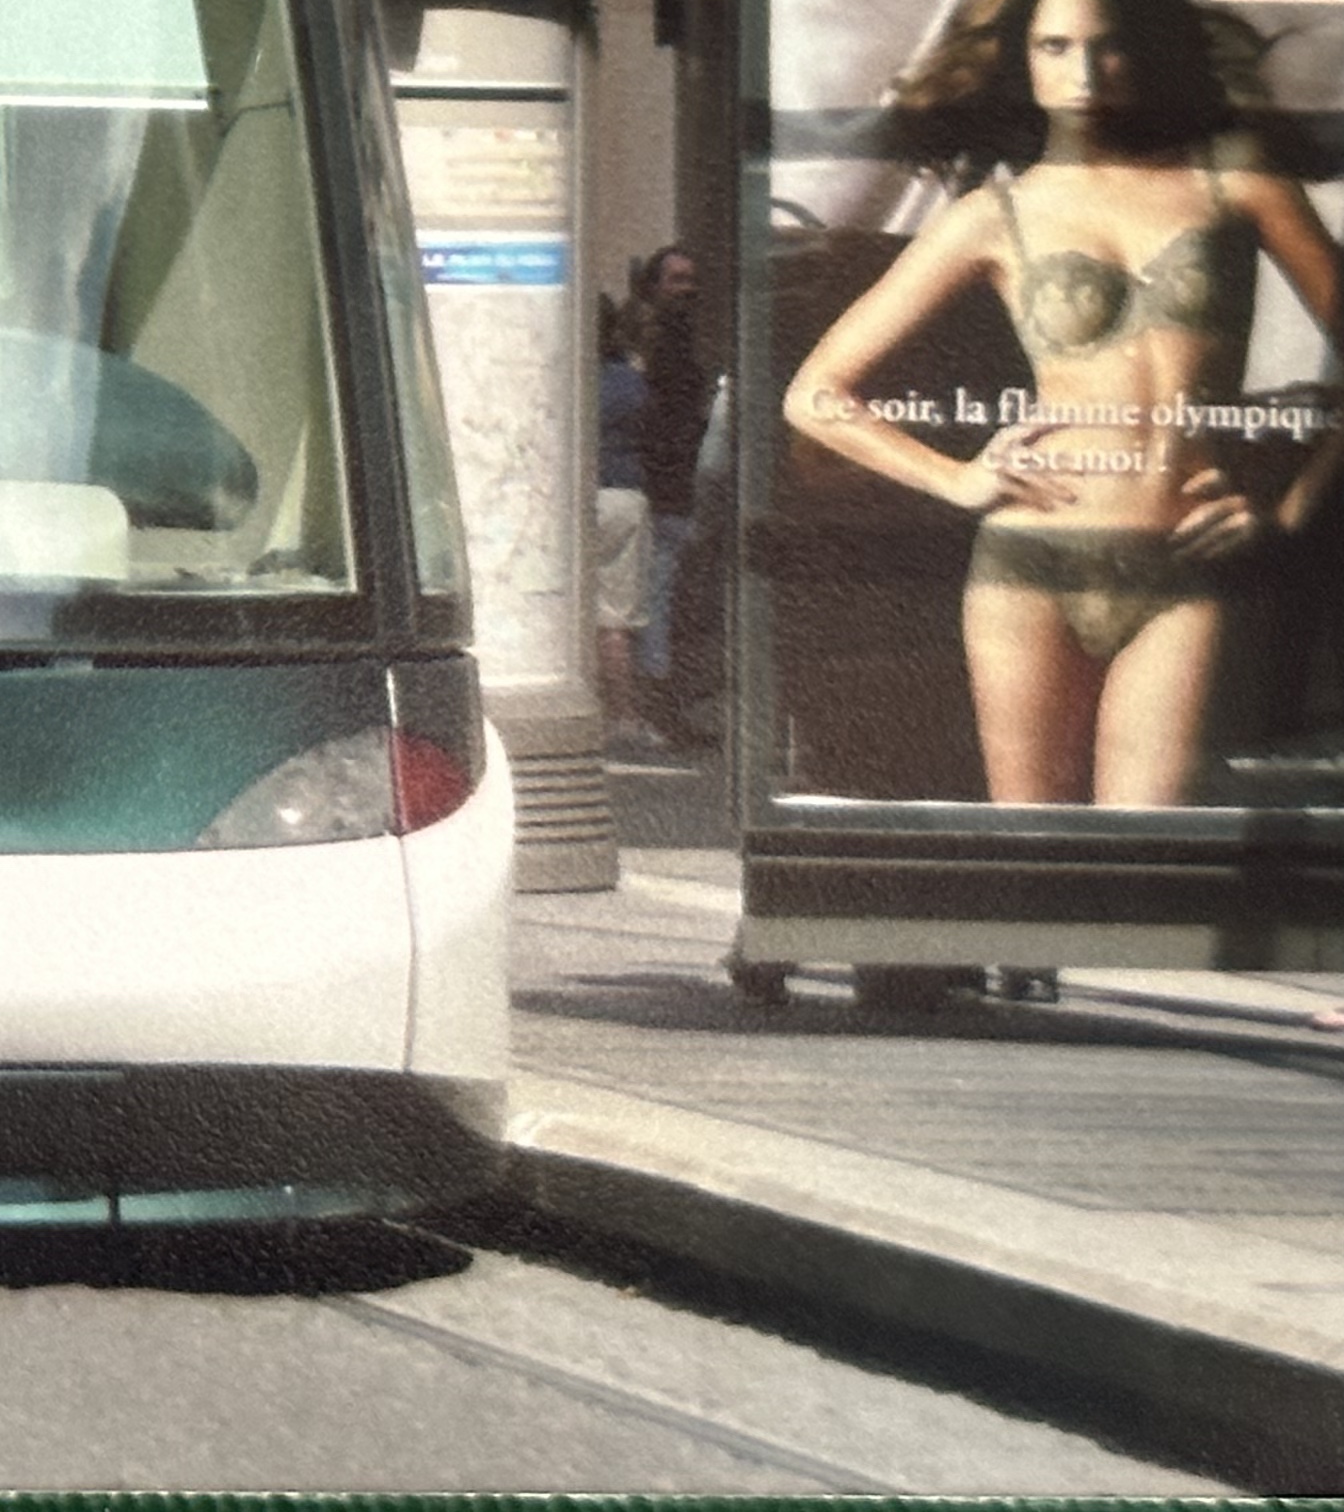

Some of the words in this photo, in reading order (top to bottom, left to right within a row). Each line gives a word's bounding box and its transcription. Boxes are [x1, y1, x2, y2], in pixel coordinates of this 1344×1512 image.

[811, 389, 857, 423] Ce
[867, 390, 946, 426] soir,
[954, 386, 989, 425] la
[998, 387, 1141, 426] flamme
